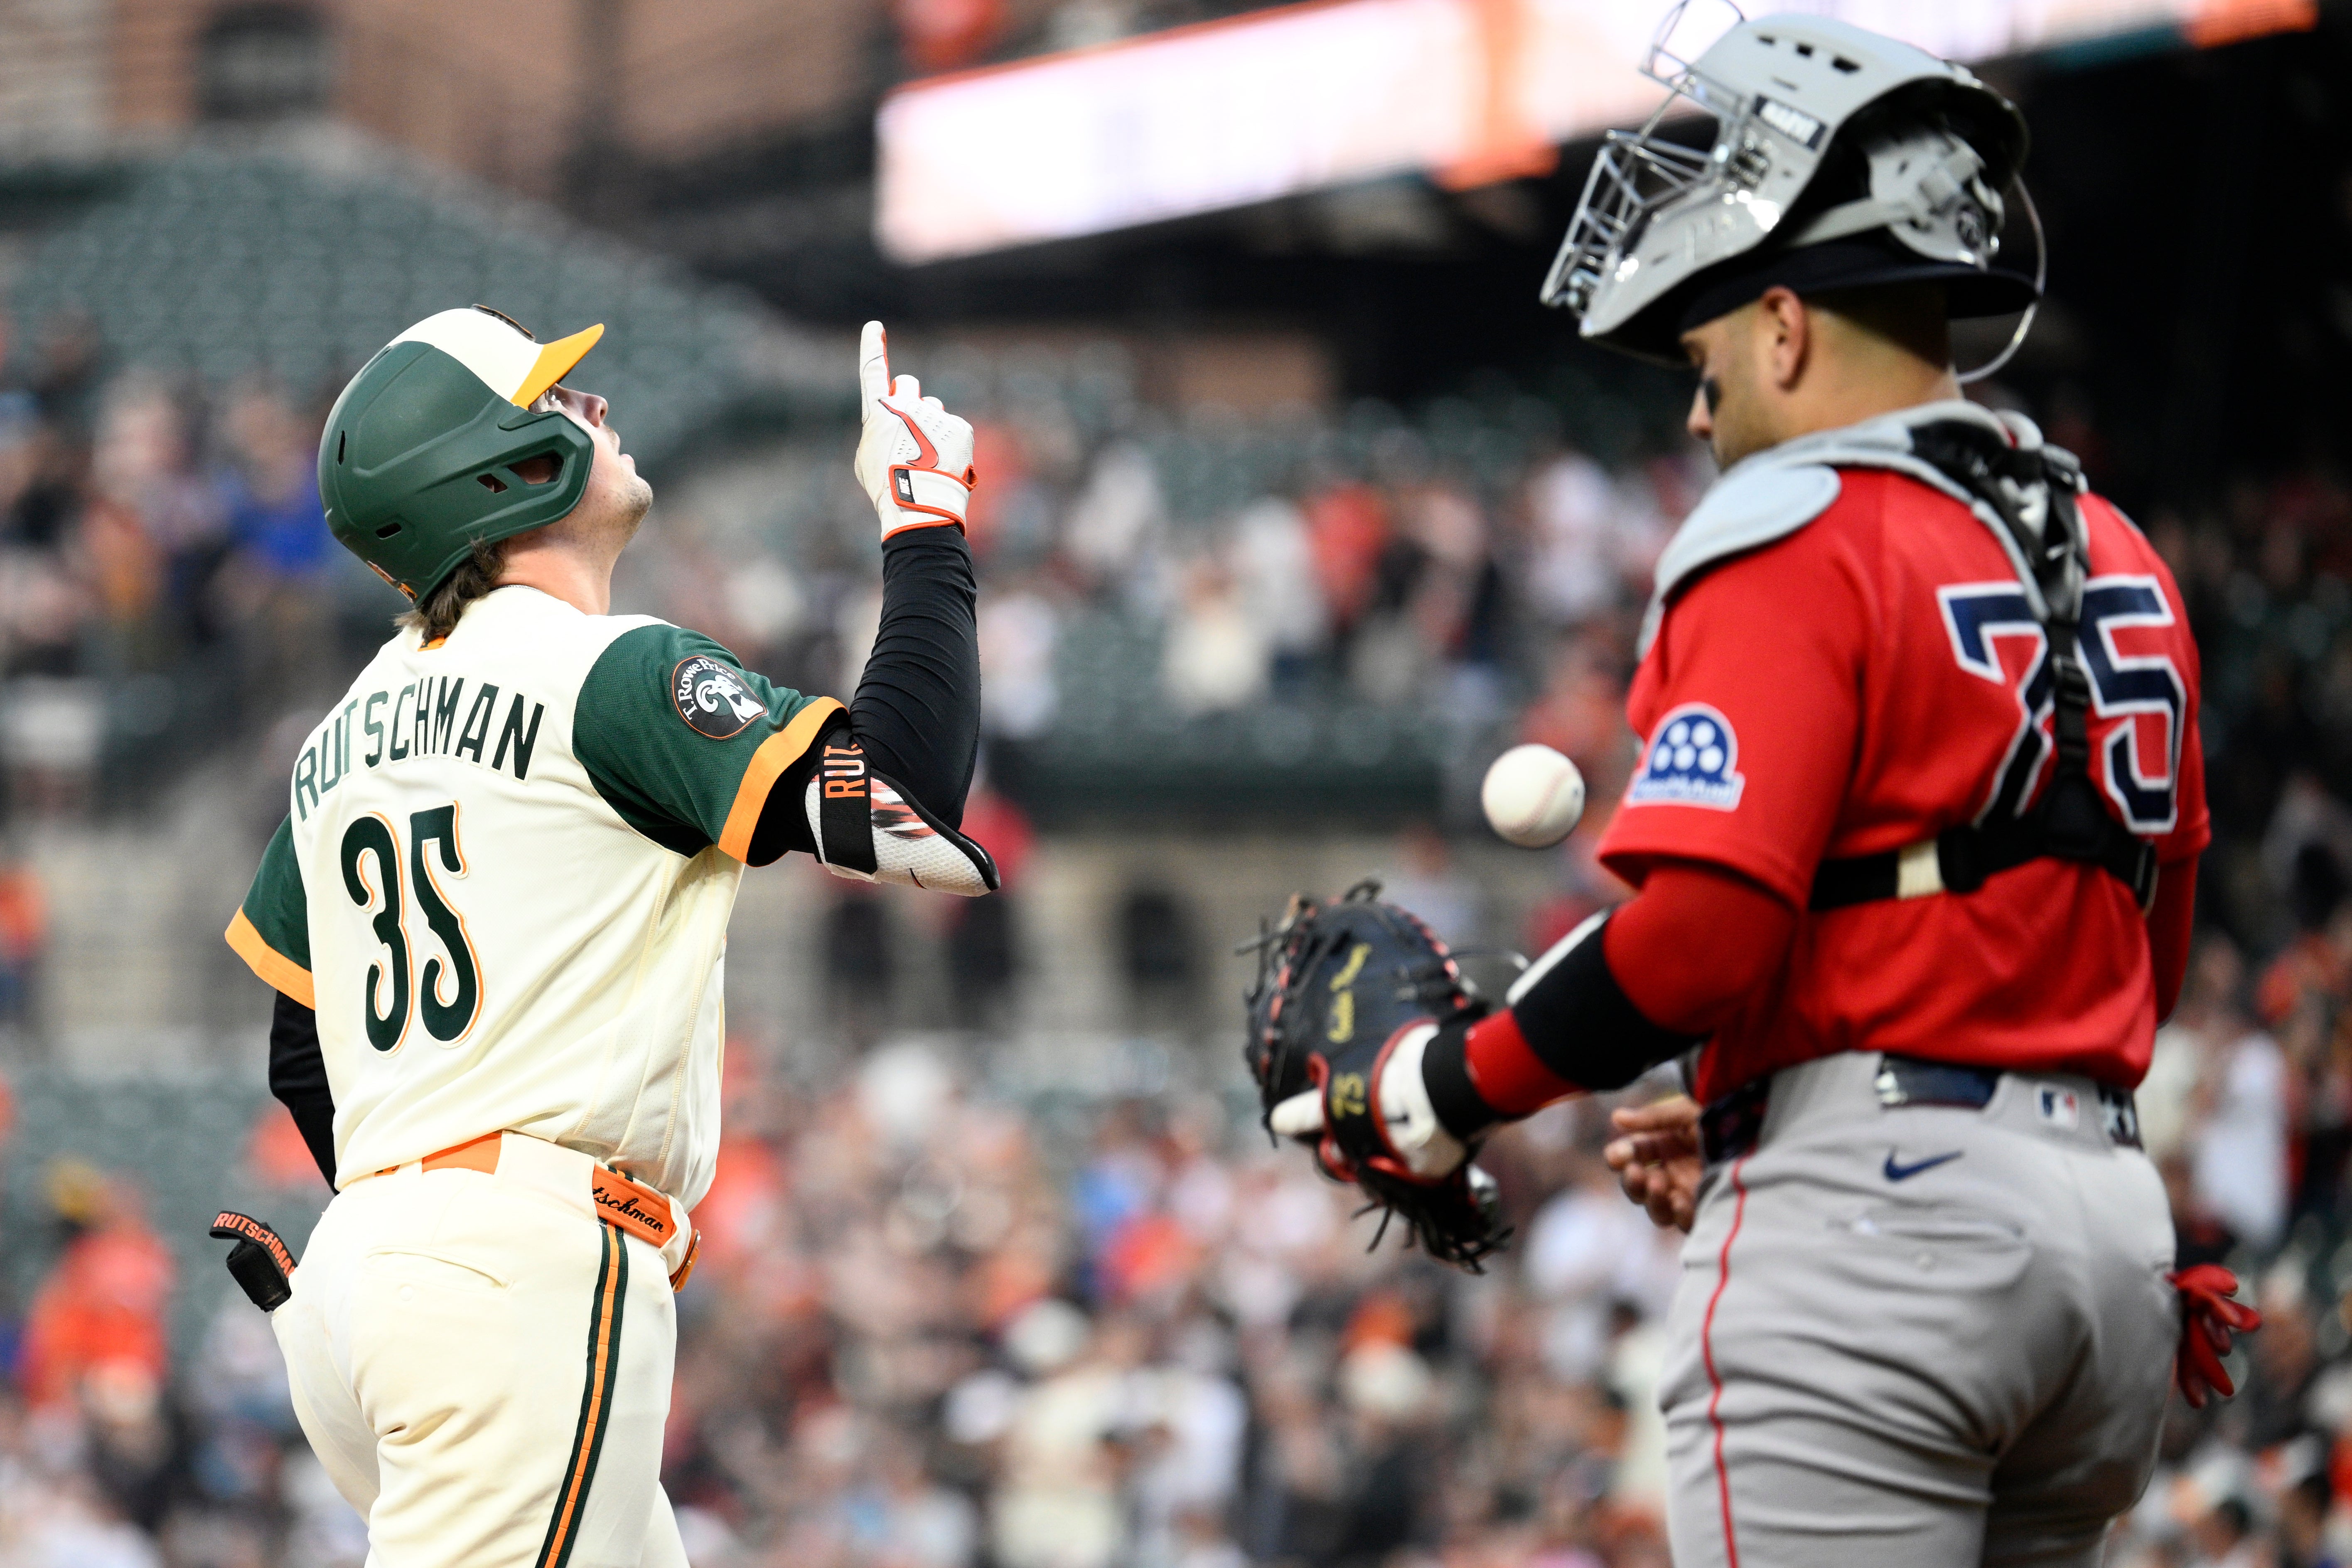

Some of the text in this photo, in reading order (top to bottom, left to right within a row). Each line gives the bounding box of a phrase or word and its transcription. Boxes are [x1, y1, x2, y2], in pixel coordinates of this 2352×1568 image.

[898, 477, 911, 495] NIKE
[678, 659, 736, 720] T. Rowe Price
[1935, 573, 2187, 834] 75
[295, 676, 548, 823] RUTSCHMAN
[823, 743, 865, 799] RUT
[340, 800, 486, 1059] 35
